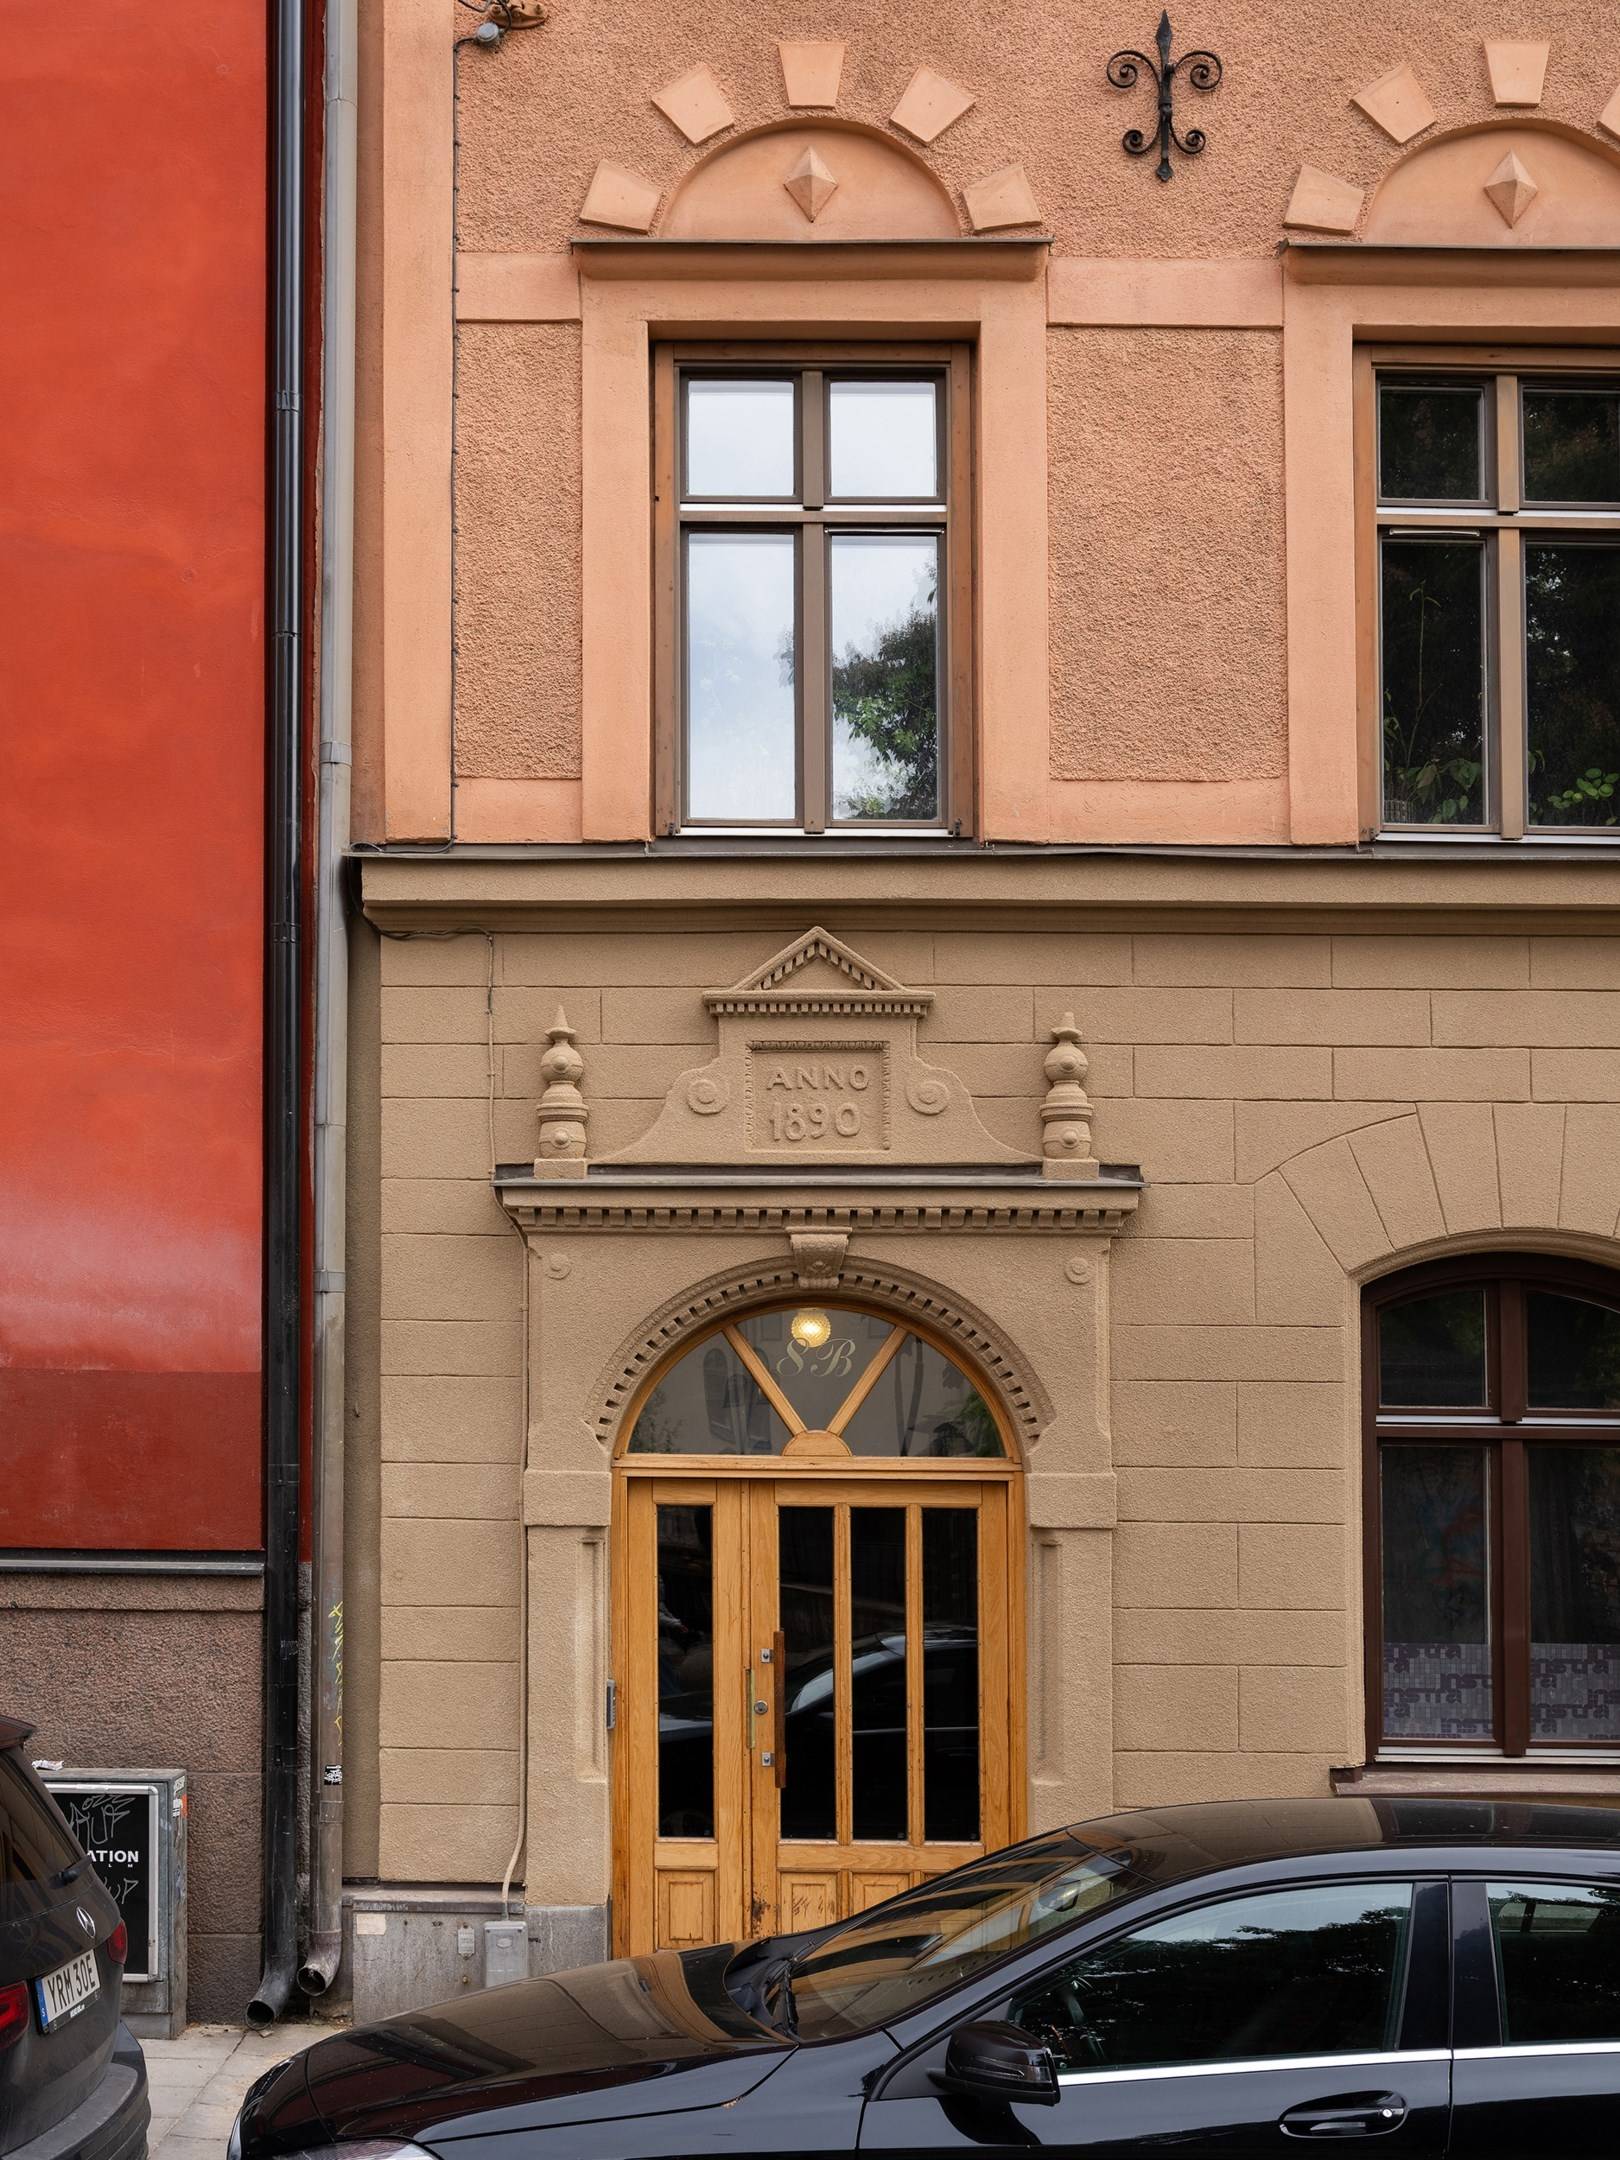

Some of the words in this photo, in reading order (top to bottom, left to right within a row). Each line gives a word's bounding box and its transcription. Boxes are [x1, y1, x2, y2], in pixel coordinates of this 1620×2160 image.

[766, 1065, 870, 1091] ANNO
[769, 1102, 862, 1141] 1890
[47, 1967, 75, 2014] YRM
[73, 1954, 96, 1997] 30E
